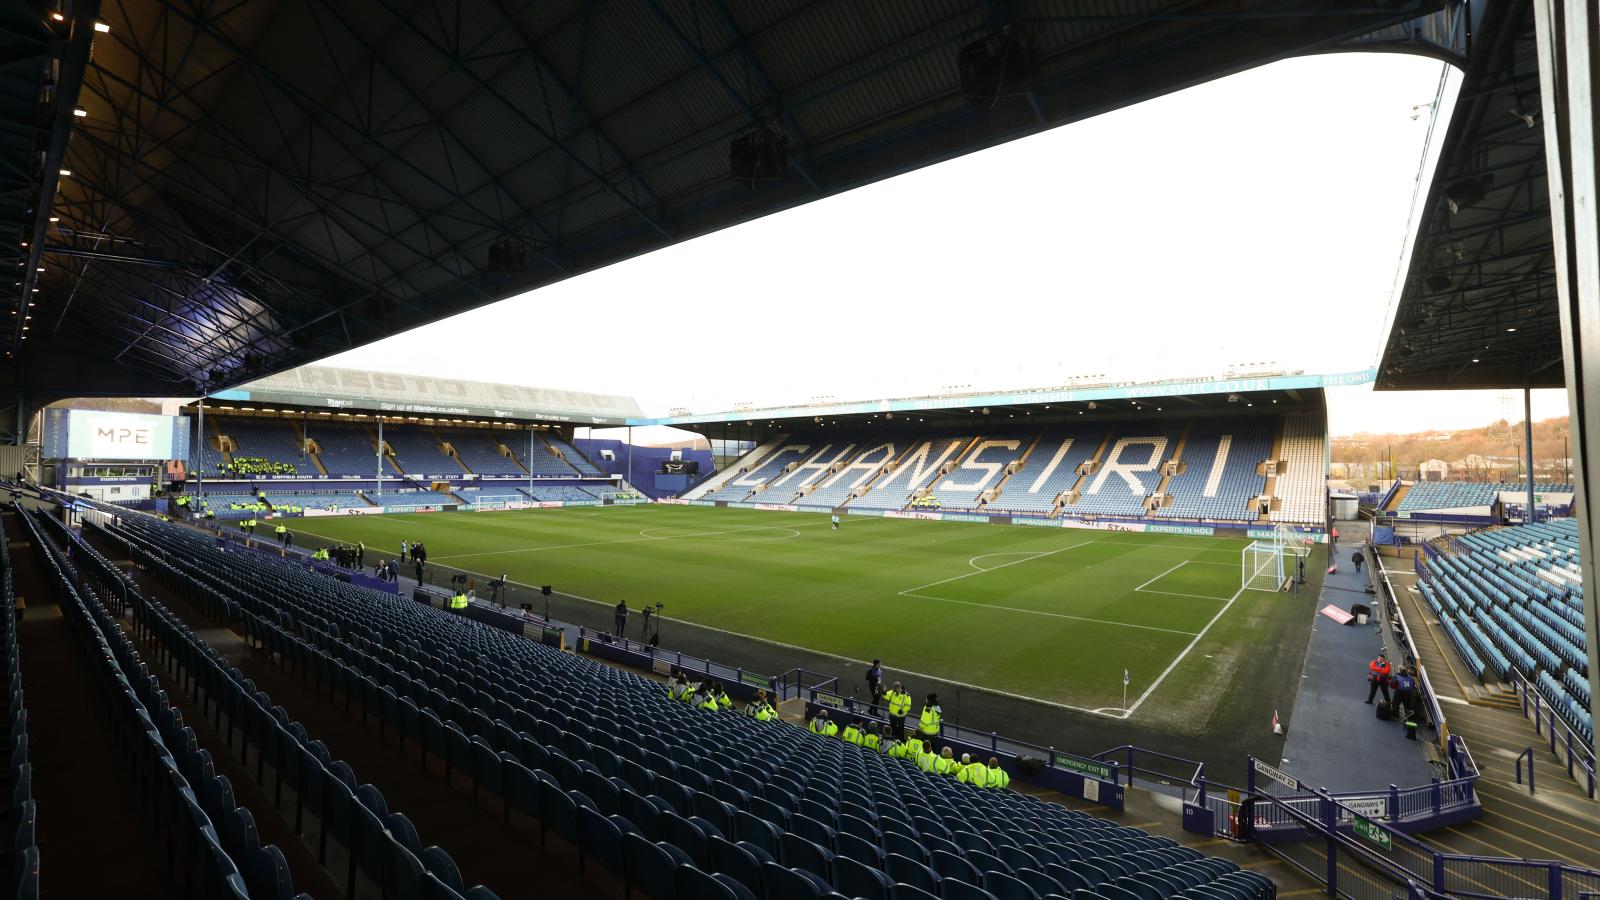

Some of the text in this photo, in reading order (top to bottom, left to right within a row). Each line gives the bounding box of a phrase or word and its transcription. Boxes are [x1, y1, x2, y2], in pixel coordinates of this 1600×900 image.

[381, 402, 396, 410] Sign
[98, 426, 149, 444] MPE
[732, 435, 1232, 498] CHANSIRI
[1151, 526, 1184, 534] EXPERTS
[1056, 757, 1100, 773] EMERGENCY EXIT
[1255, 762, 1297, 788] GANGWAY 22
[1354, 819, 1368, 832] Exit
